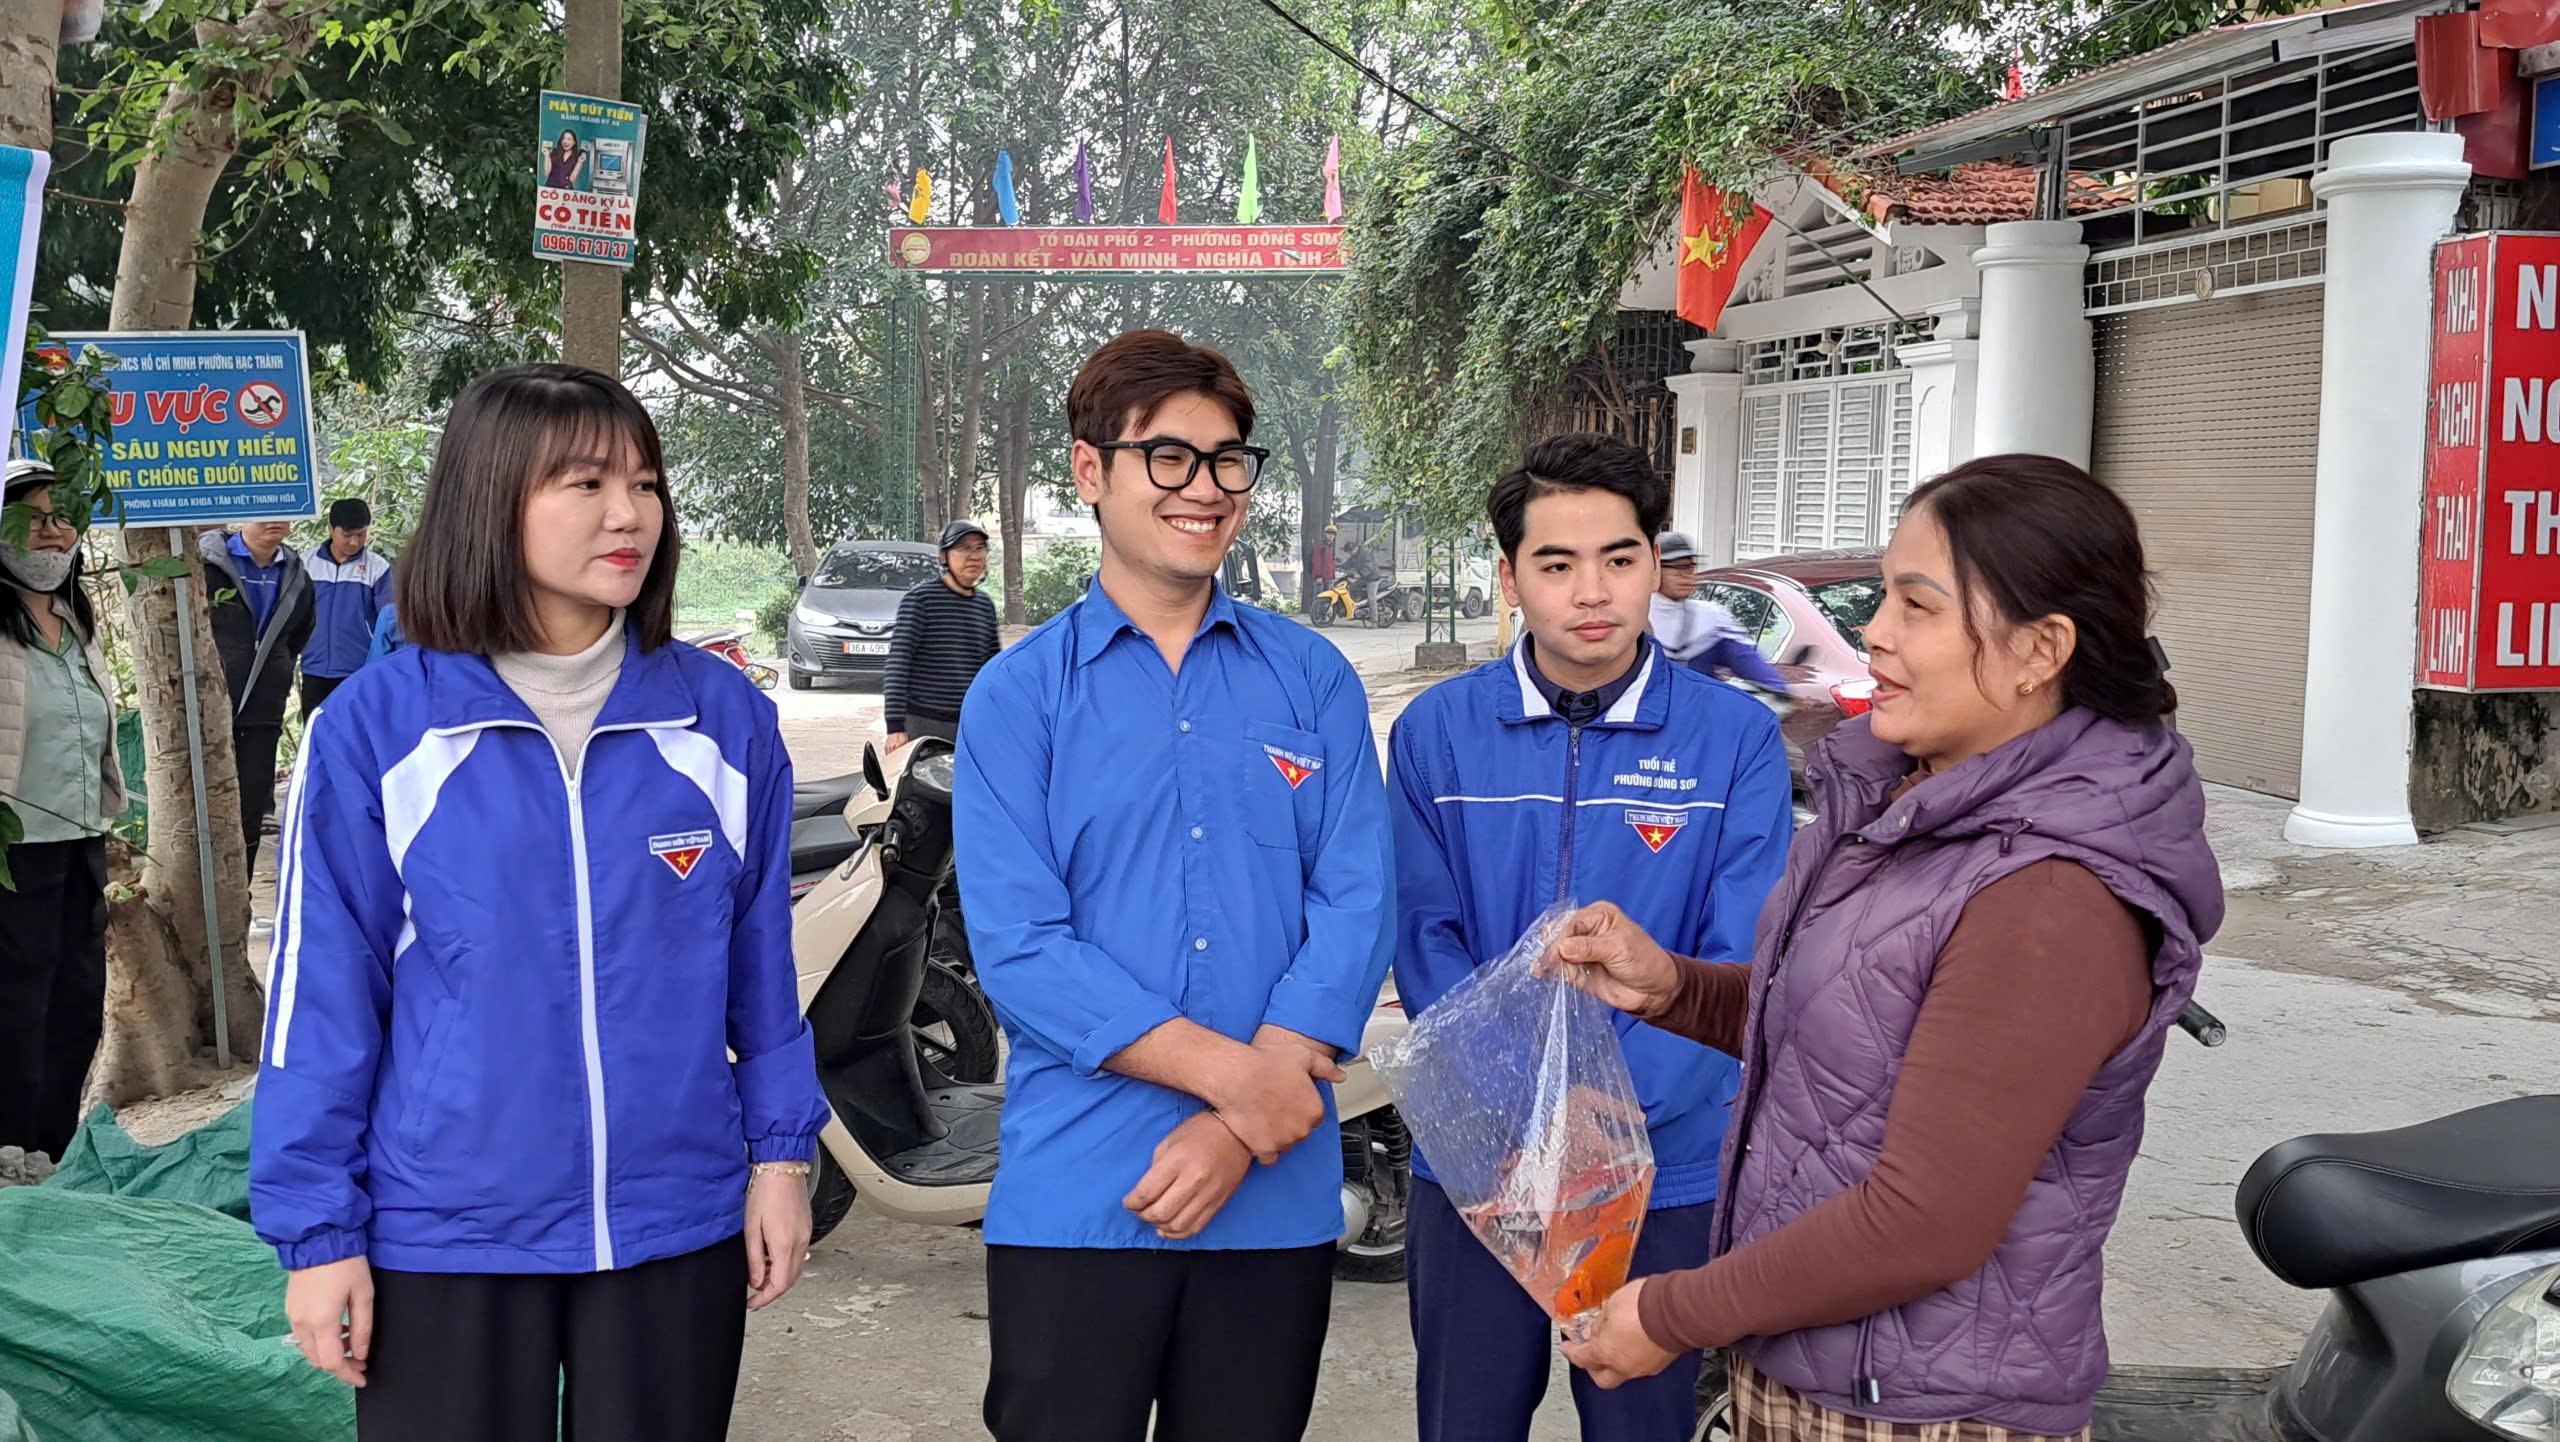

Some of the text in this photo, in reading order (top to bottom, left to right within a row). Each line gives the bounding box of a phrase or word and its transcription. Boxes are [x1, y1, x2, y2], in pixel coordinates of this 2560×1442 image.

[548, 99, 577, 112] MÁY
[540, 188, 559, 201] CÓ
[562, 191, 597, 206] ĐĂNG
[618, 198, 630, 209] LÀ
[538, 202, 632, 230] CÓ TIỀN
[541, 233, 628, 259] 0966 67 37 37
[1063, 232, 1099, 247] DÂN
[1104, 230, 1138, 247] PHỐ
[1143, 235, 1155, 247] 2
[1247, 231, 1296, 246] ĐÔNG
[950, 248, 1008, 267] ĐOÀN
[1014, 248, 1052, 267] KẾT
[1071, 249, 1113, 267] VĂN
[1120, 252, 1177, 267] MINH
[1196, 249, 1264, 267] NGHĨA
[2446, 251, 2479, 334] NHÀ
[173, 356, 197, 371] MINH
[255, 352, 284, 369] THÀNH
[145, 383, 231, 434] VỰC
[111, 438, 158, 461] SÂU
[166, 439, 229, 460] NGUY
[238, 432, 297, 457] HIỂM
[137, 461, 198, 487] CHỐNG
[204, 460, 246, 484] ĐUỐI
[251, 463, 299, 483] NƯỚC
[252, 494, 279, 504] THANH
[2436, 480, 2471, 561] THÁI
[2429, 607, 2467, 674] LINH
[1263, 743, 1285, 759] THANH
[1311, 760, 1324, 770] NA
[1613, 772, 1653, 788] PHƯỜNG
